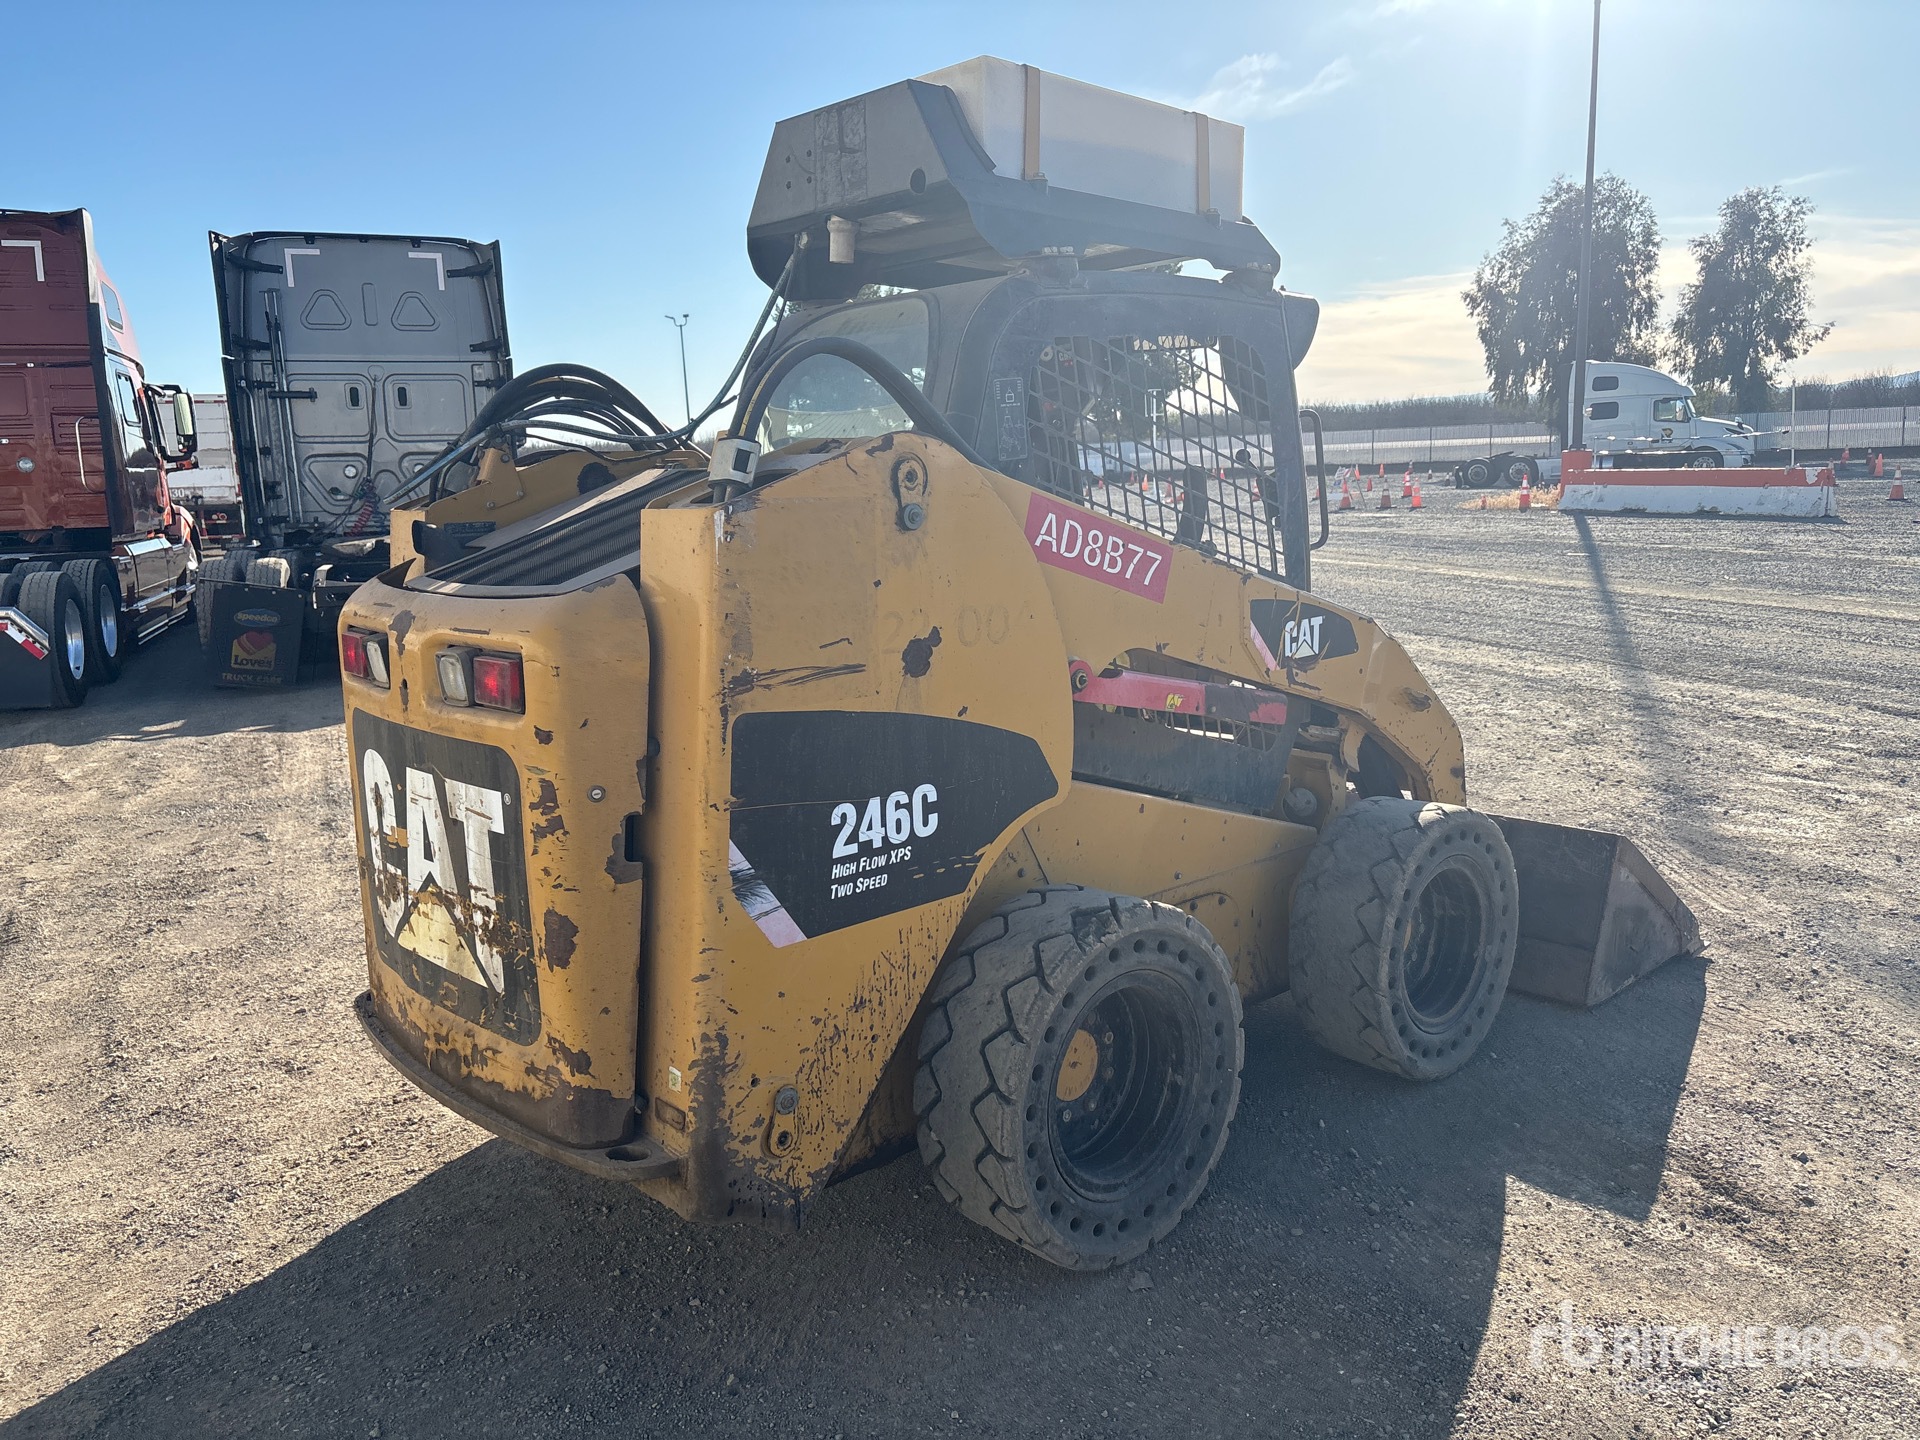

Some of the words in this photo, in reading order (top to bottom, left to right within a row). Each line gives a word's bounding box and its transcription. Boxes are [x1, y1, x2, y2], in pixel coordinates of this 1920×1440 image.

[1034, 513, 1163, 586] AD8B77
[1284, 615, 1323, 658] CAT
[831, 783, 939, 859] 246C
[889, 846, 912, 865] XPS
[363, 748, 506, 994] CAT
